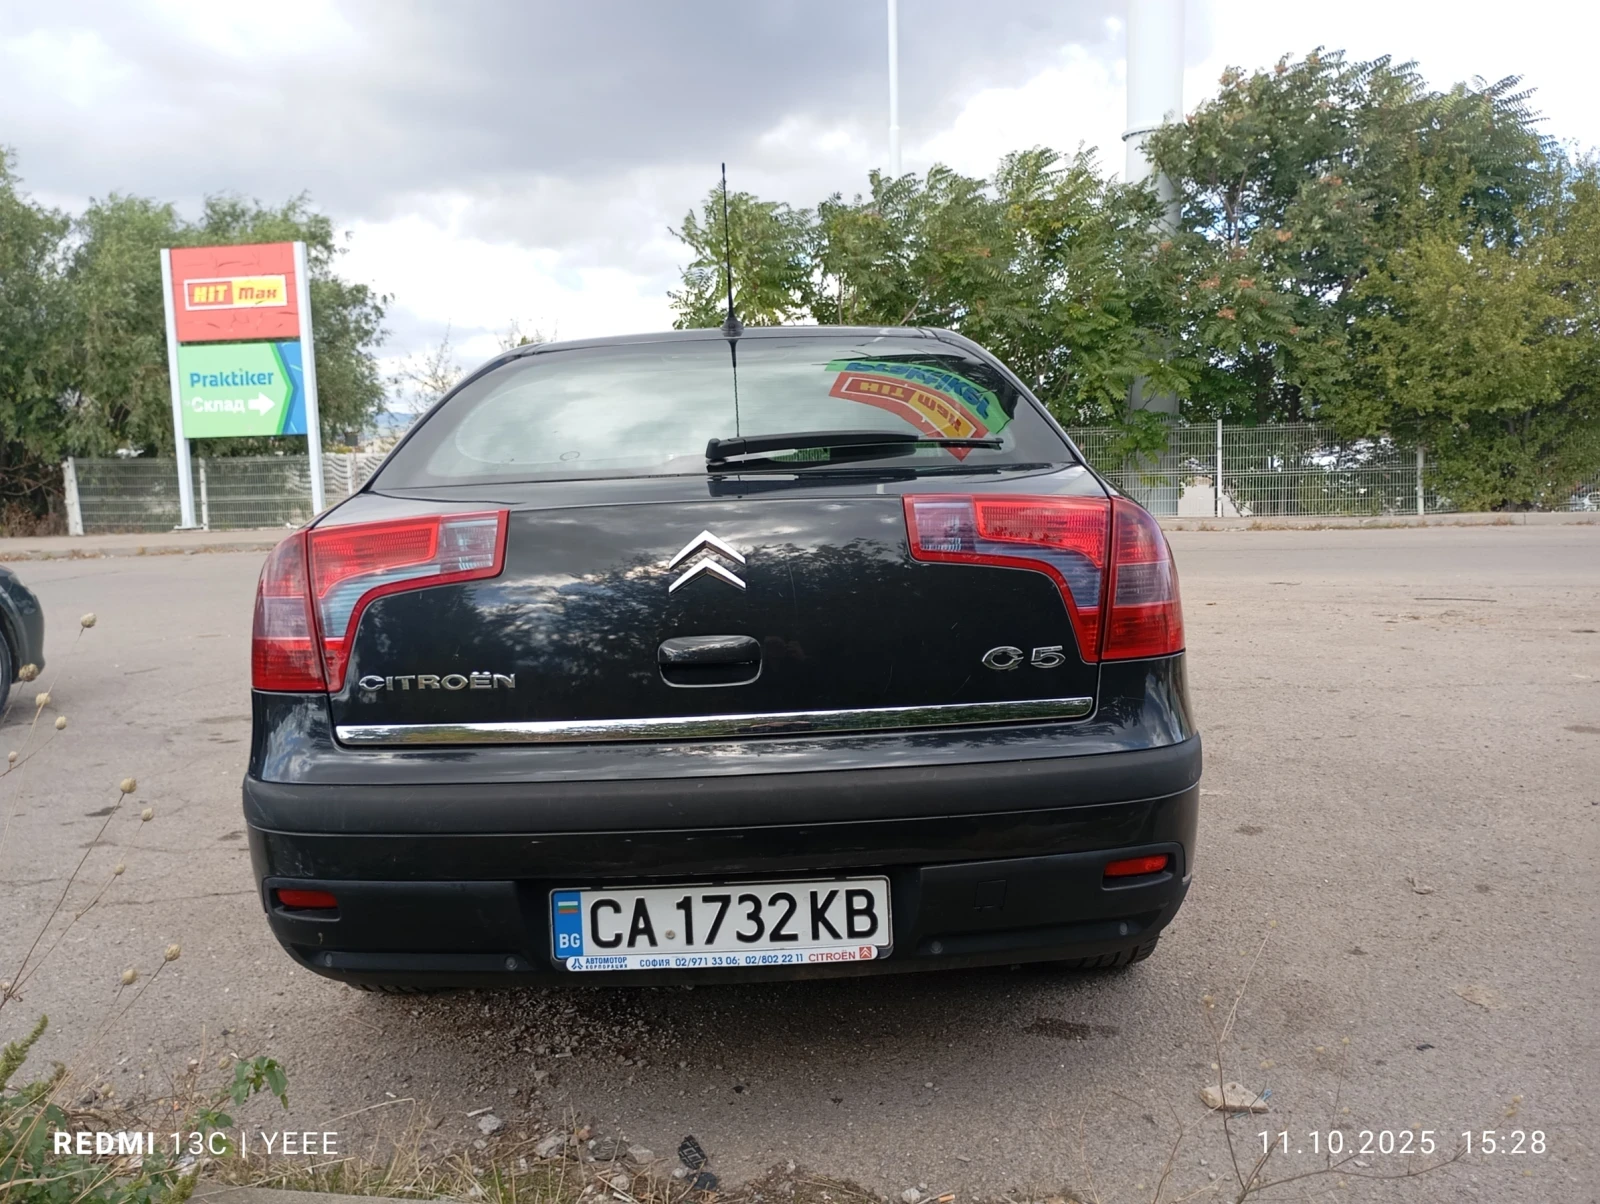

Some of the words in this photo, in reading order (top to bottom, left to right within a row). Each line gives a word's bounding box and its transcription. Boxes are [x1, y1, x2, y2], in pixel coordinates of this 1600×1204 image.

[193, 284, 228, 303] HIT
[190, 371, 274, 388] Praktiker
[191, 396, 246, 414] Склад
[359, 671, 516, 691] CITROËN
[589, 896, 659, 949] CA
[675, 892, 799, 946] 1732
[809, 888, 879, 941] KB
[559, 933, 581, 949] BG
[585, 956, 627, 964] АВТОМОТОР
[639, 958, 671, 968] СОФИЯ
[675, 956, 708, 967] 02/971
[711, 956, 723, 966] 33
[745, 954, 779, 965] 02/802
[781, 953, 793, 963] 22
[796, 953, 804, 962] 11
[808, 949, 856, 962] CITROËN
